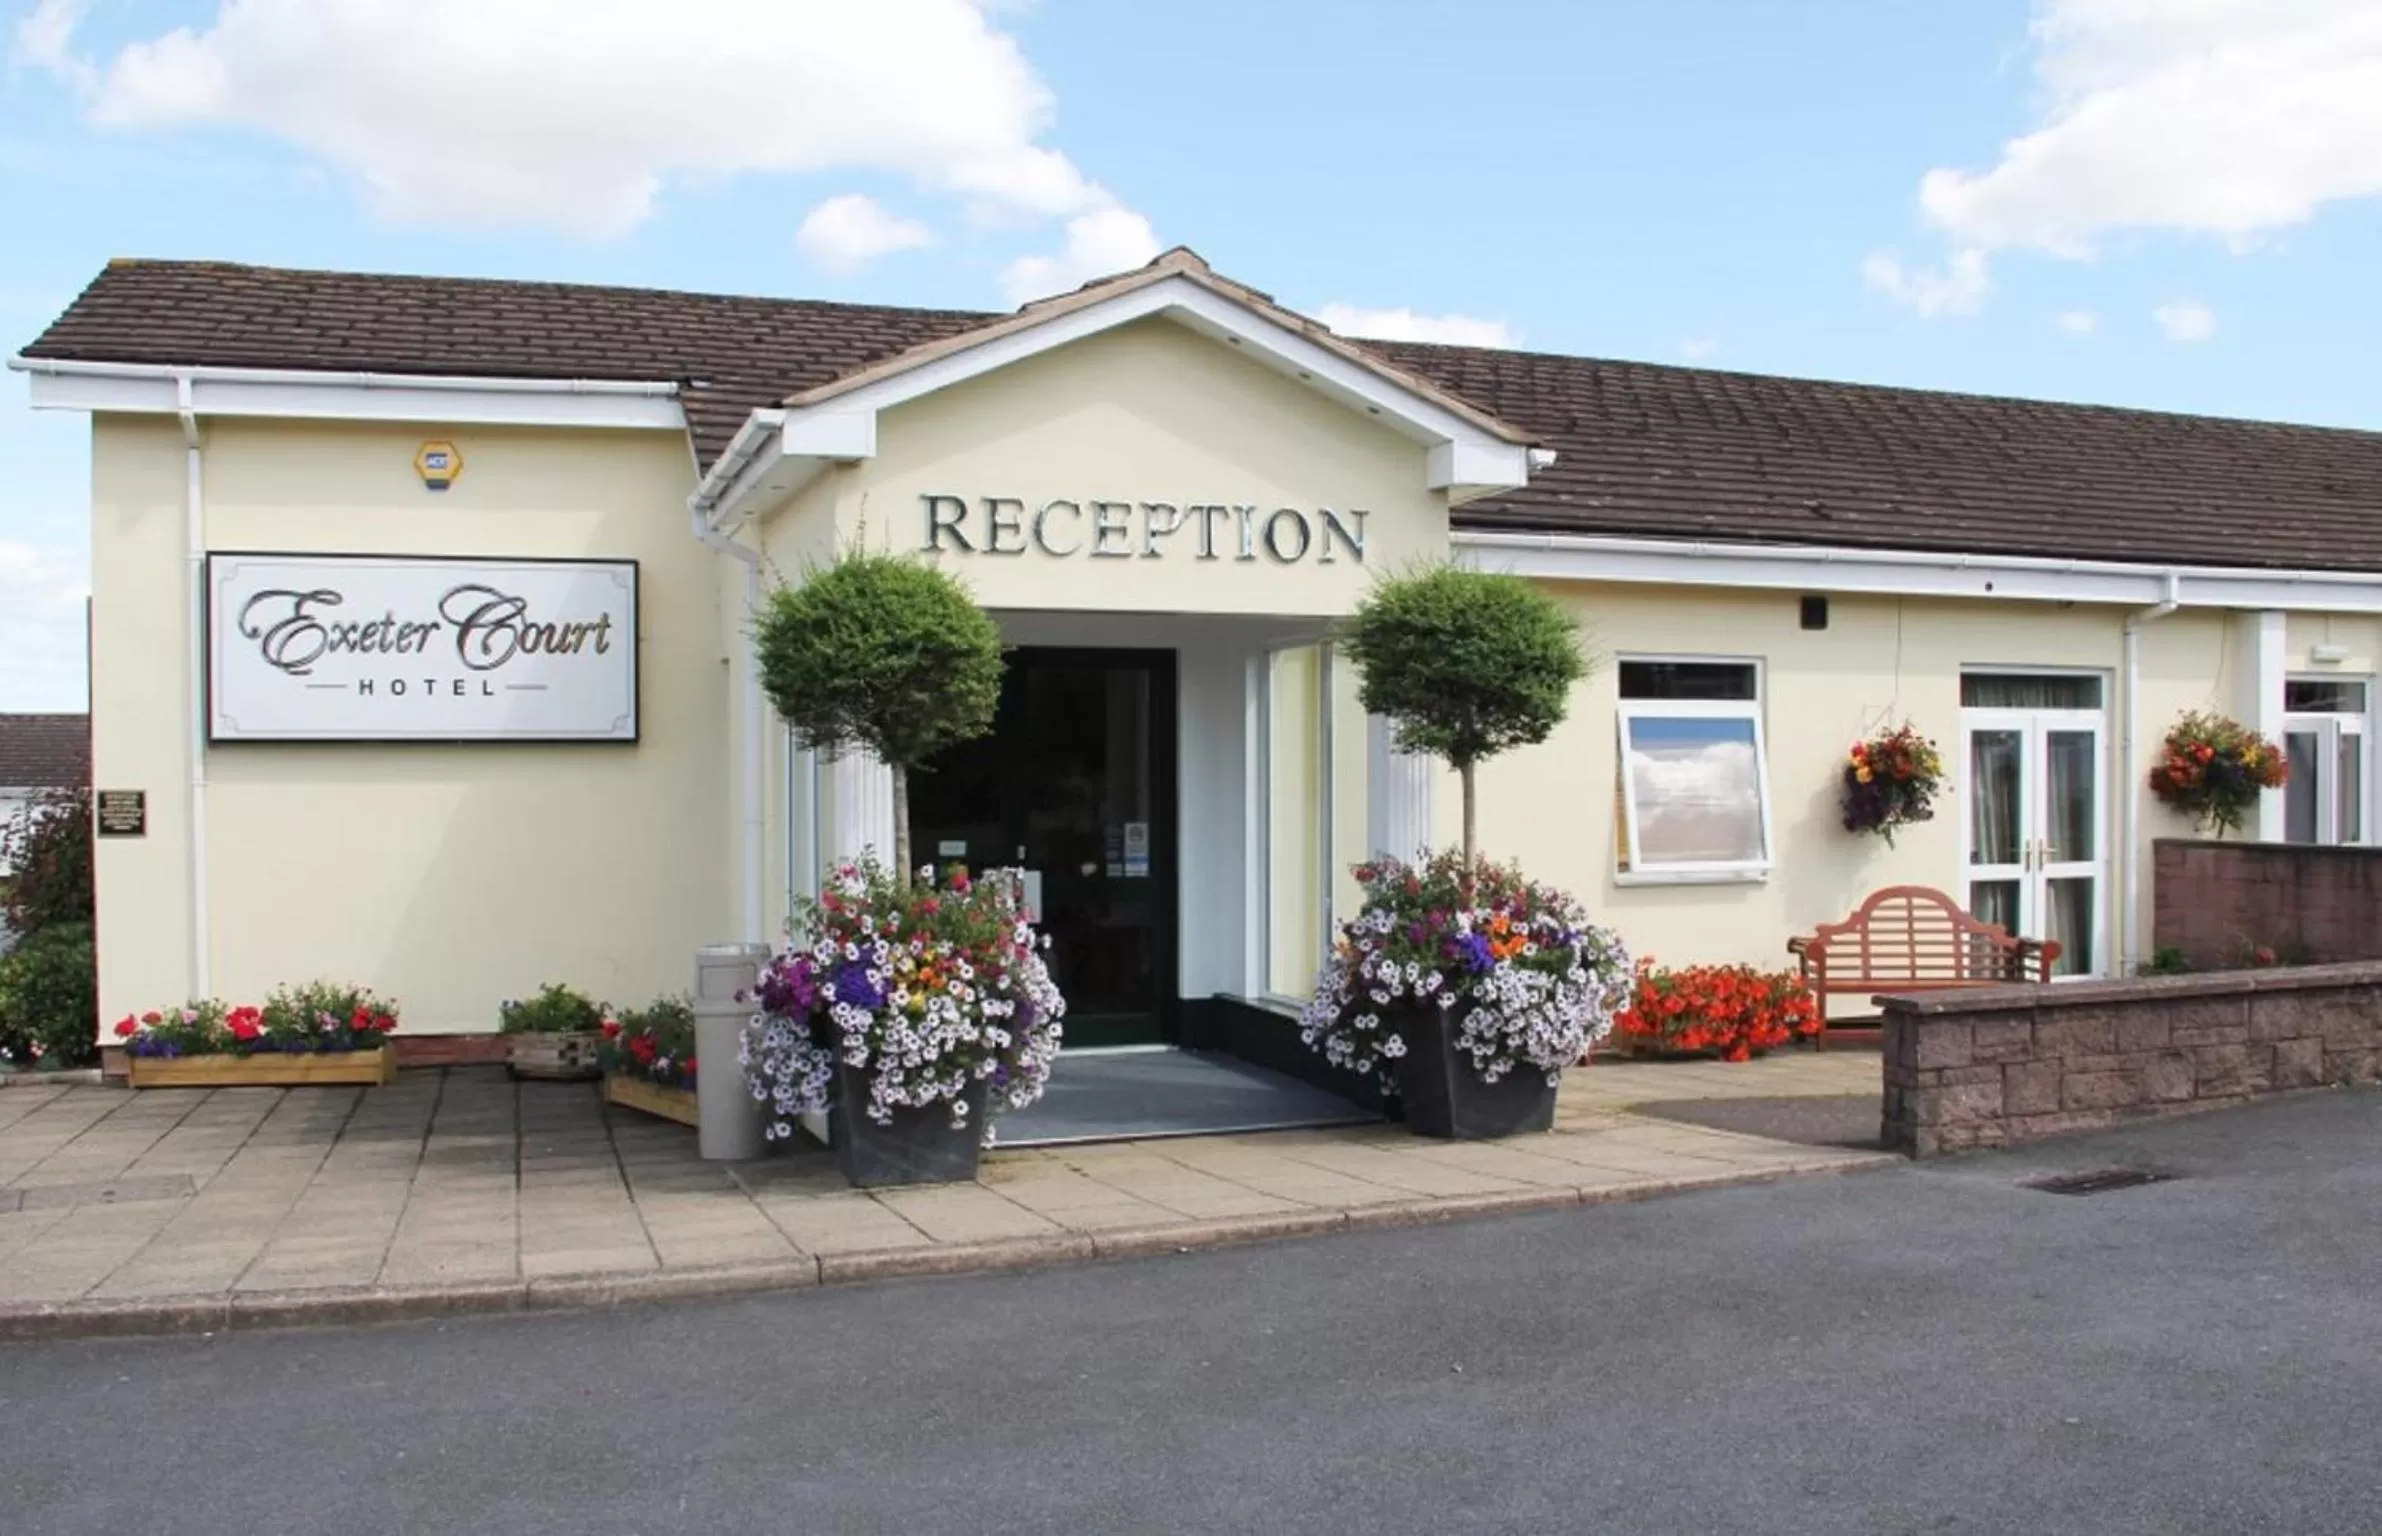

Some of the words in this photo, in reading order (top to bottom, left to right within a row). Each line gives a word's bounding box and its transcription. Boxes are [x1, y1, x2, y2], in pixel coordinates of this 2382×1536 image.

[918, 493, 1370, 565] RECEPTION
[237, 588, 441, 676] Exeter
[438, 583, 612, 672] Court
[358, 678, 496, 697] HOTEL
